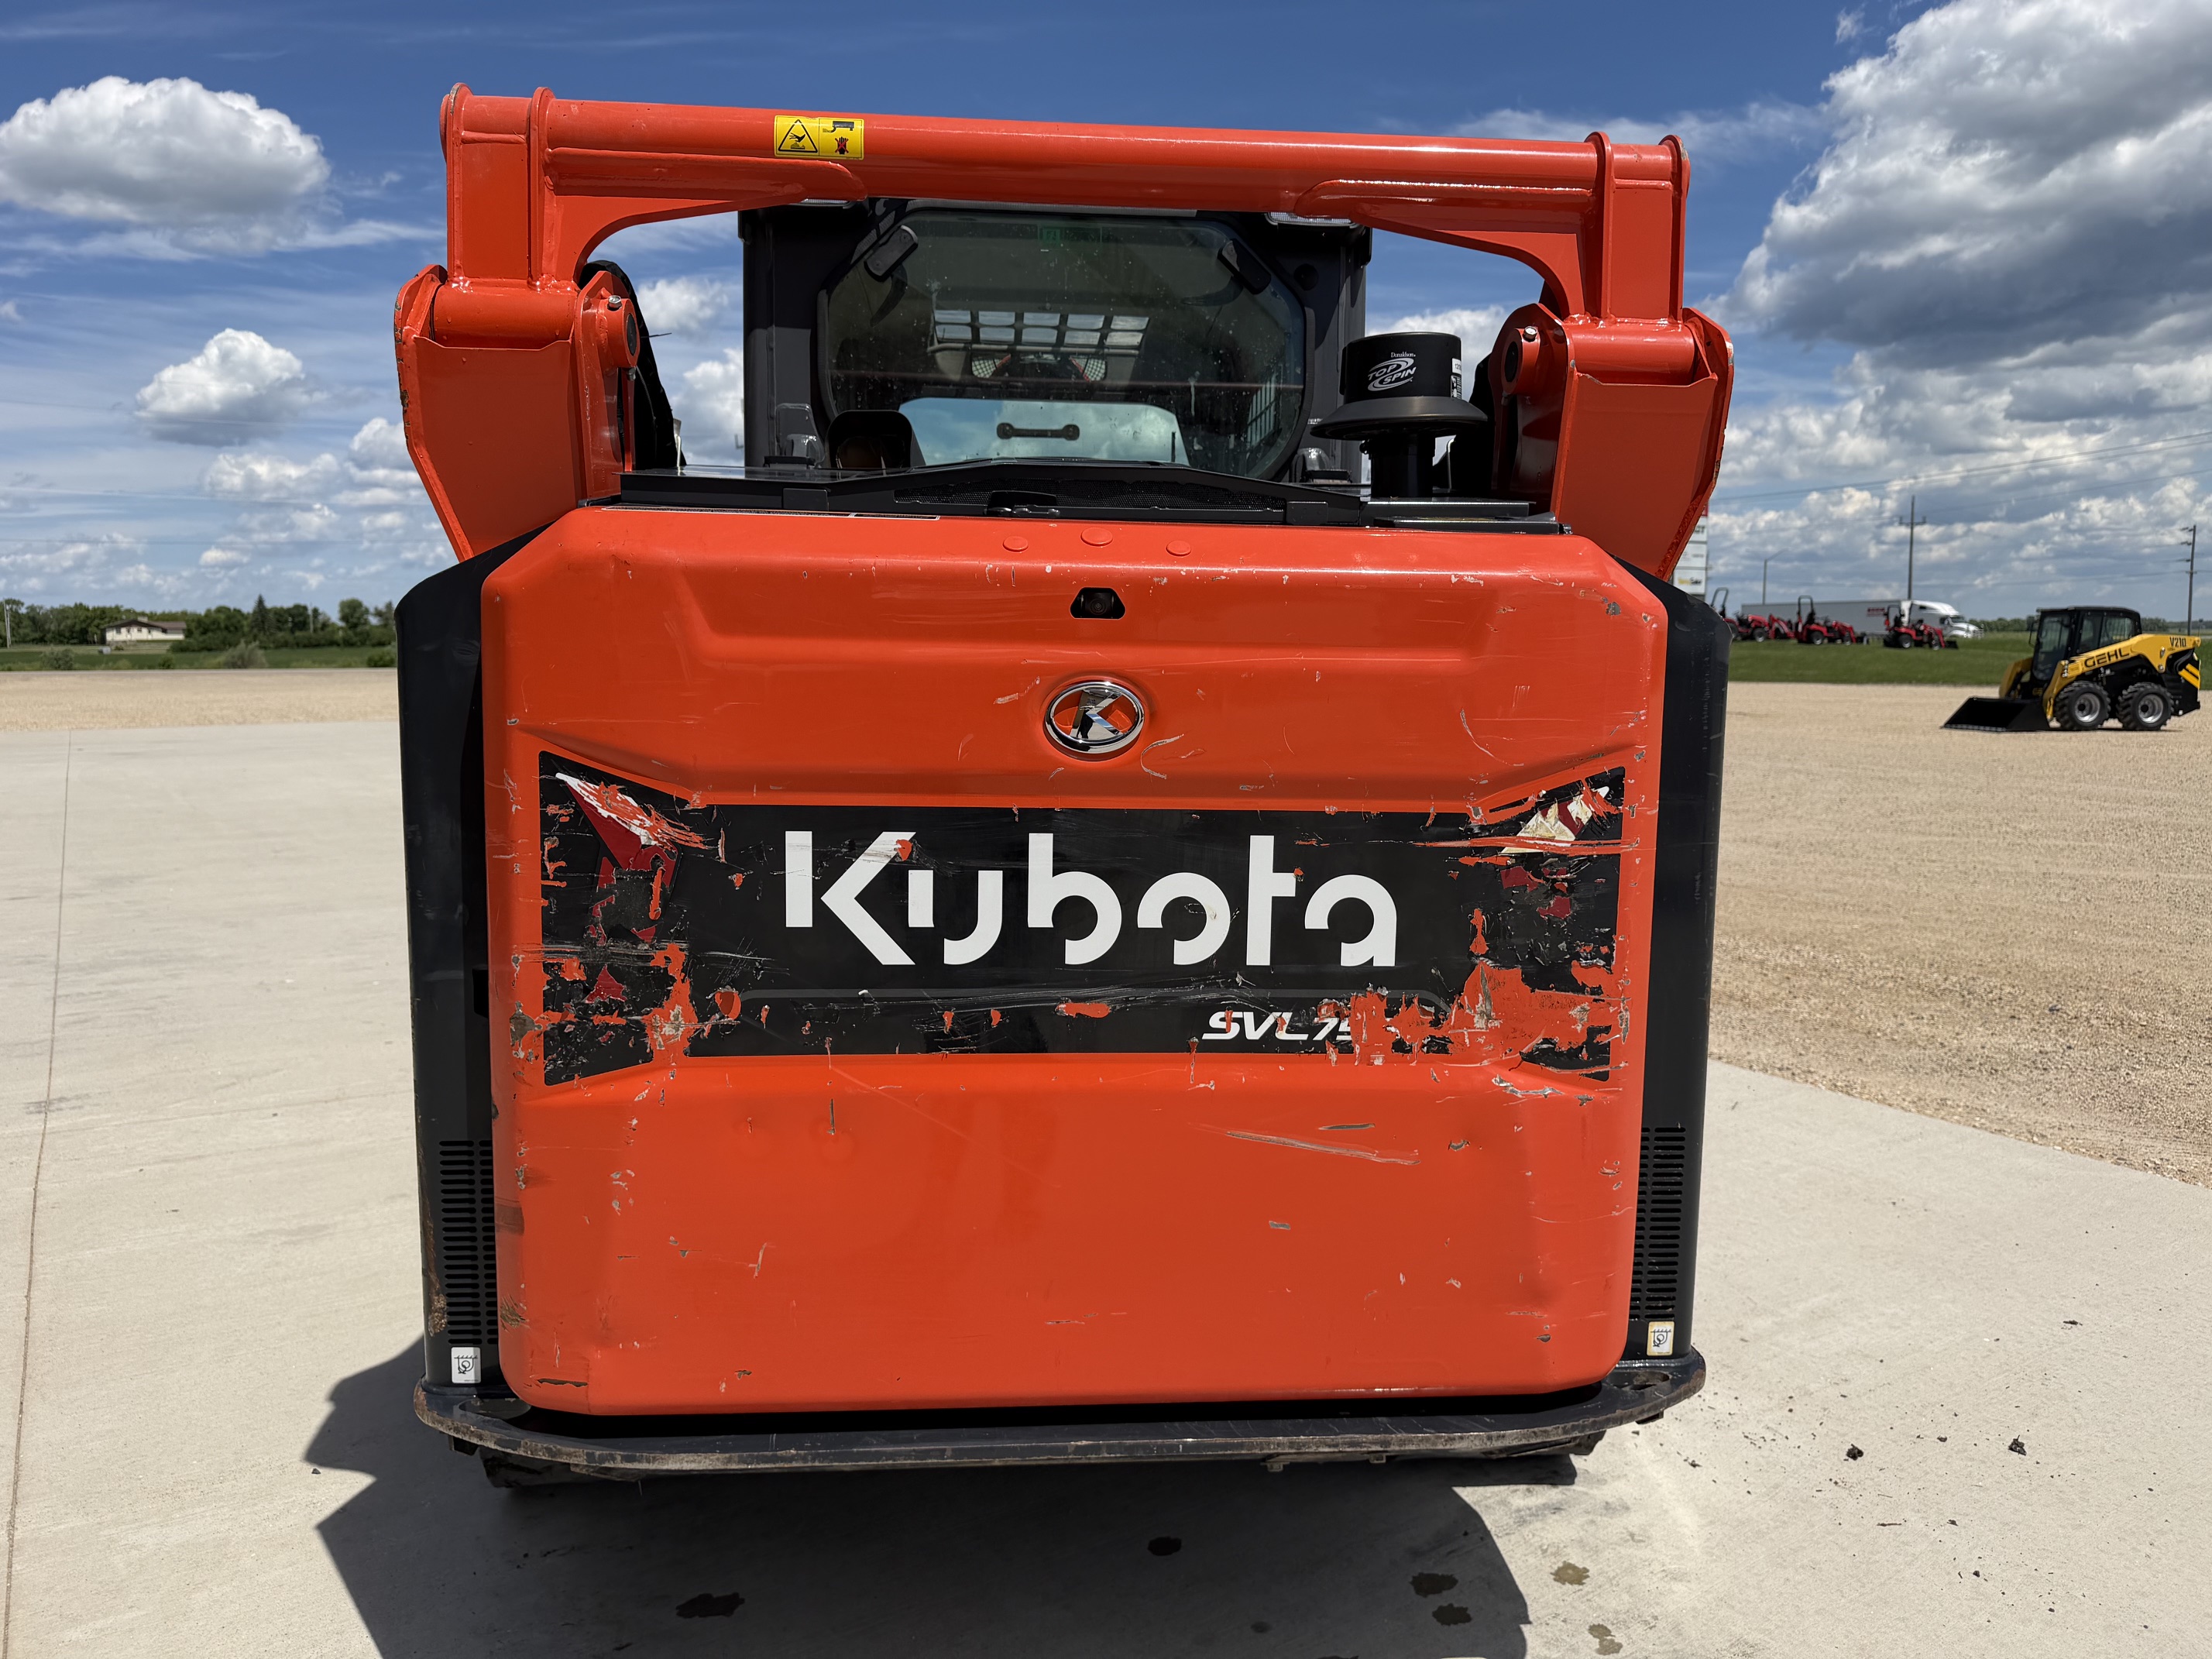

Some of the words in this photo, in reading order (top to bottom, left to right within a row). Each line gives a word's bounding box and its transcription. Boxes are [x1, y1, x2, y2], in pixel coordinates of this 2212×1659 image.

[1368, 364, 1397, 381] TOP
[1382, 366, 1417, 385] SPIN
[2169, 636, 2186, 647] V210
[2084, 647, 2129, 668] GEHL
[785, 830, 1396, 967] Kubota
